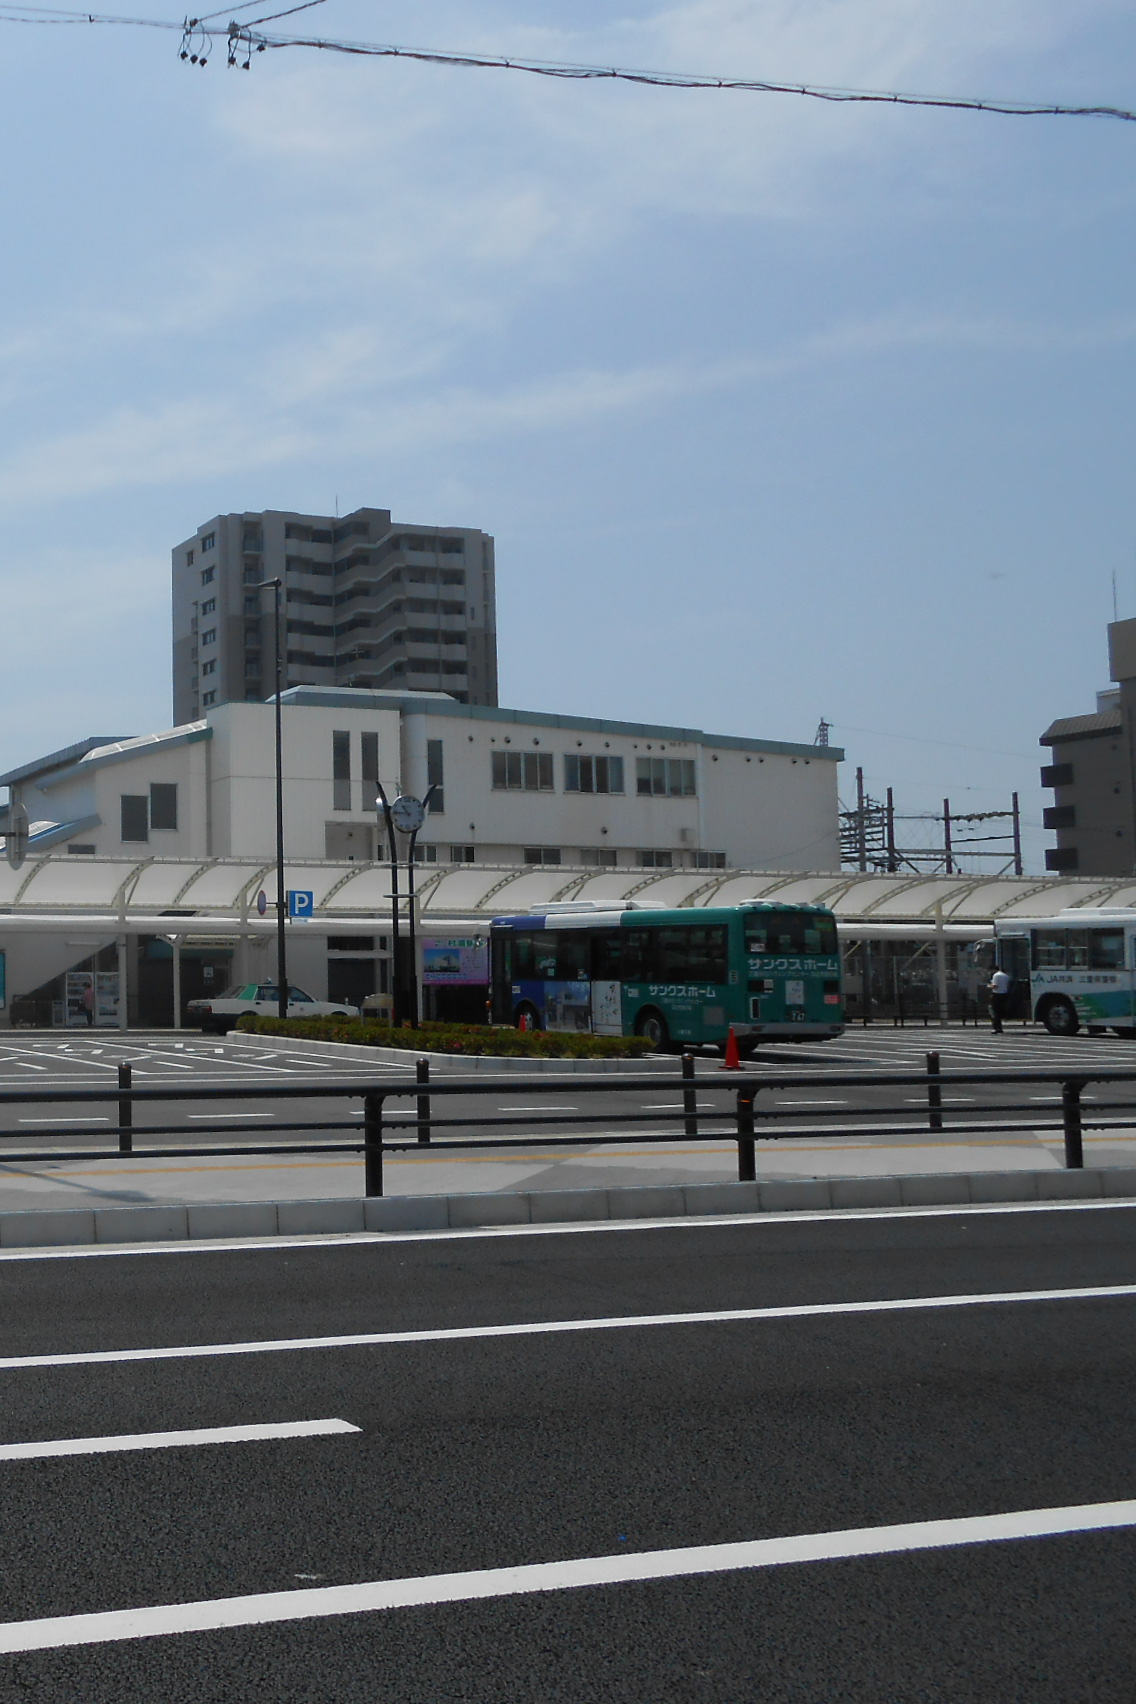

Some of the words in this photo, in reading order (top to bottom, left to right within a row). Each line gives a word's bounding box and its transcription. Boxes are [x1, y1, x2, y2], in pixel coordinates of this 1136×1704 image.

[294, 893, 310, 915] P
[747, 958, 838, 970] サンクスホーム
[648, 985, 716, 998] サンクスホーム
